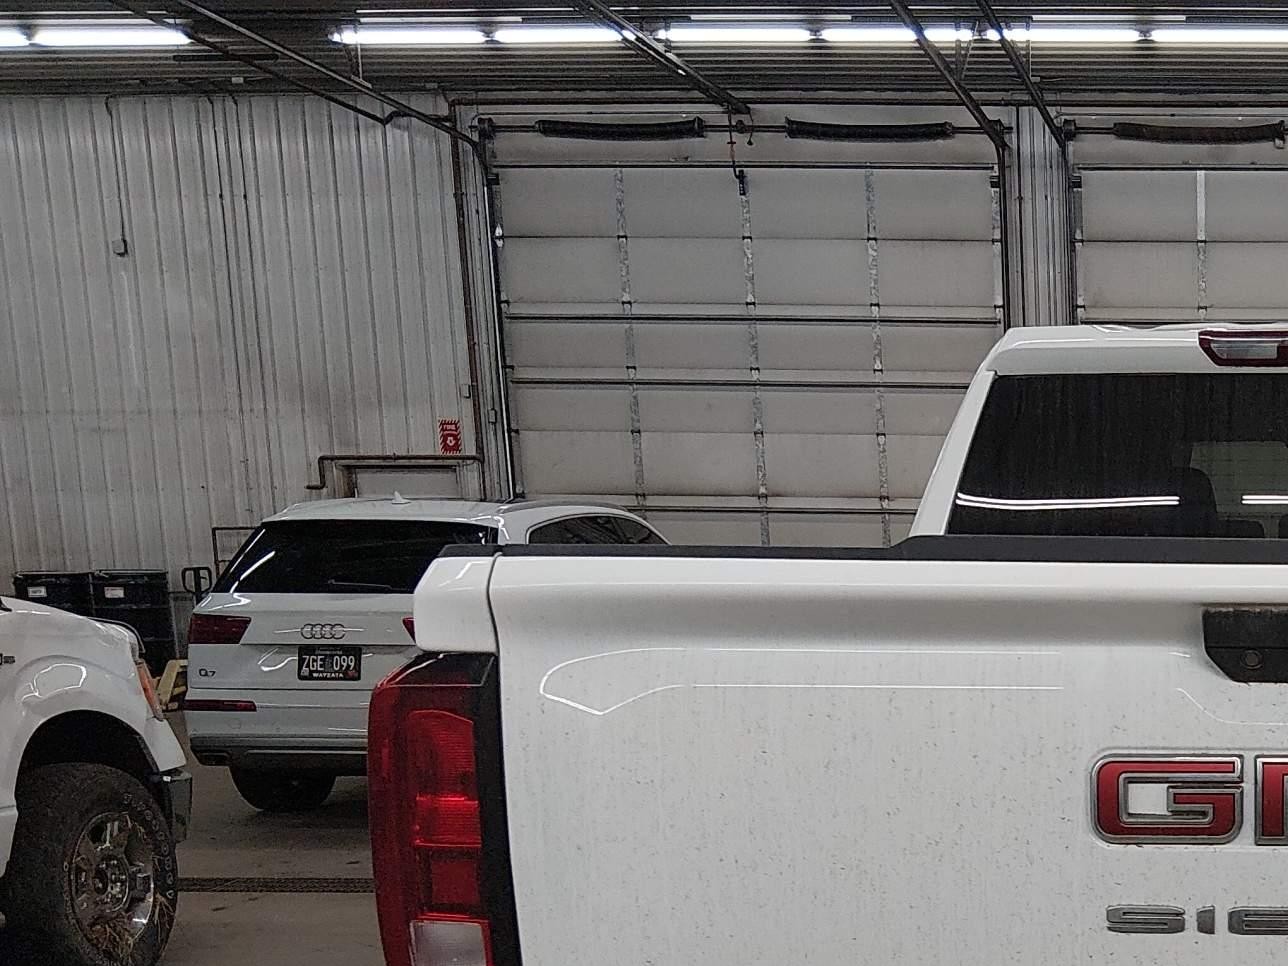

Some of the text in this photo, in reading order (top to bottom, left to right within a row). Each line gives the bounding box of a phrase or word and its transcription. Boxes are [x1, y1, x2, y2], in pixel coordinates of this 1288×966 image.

[302, 655, 355, 671] ZGE 099
[199, 668, 216, 677] Q7
